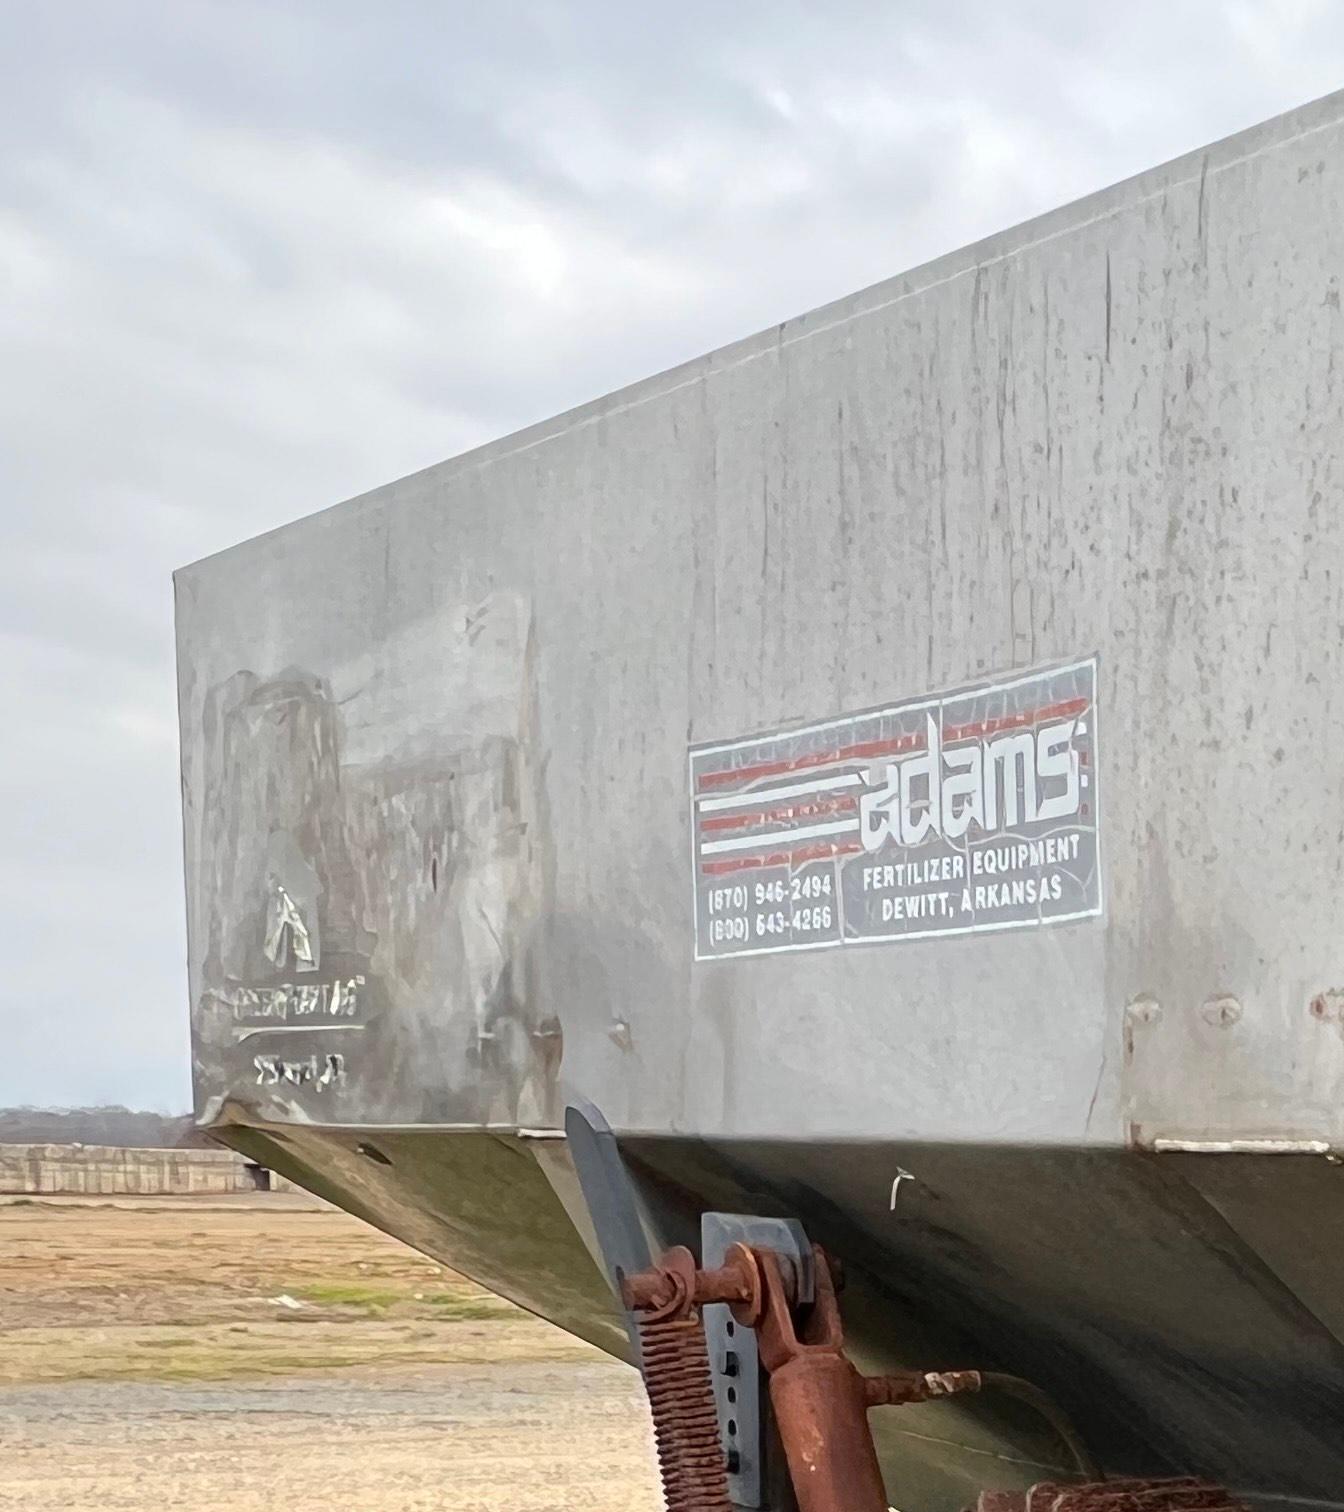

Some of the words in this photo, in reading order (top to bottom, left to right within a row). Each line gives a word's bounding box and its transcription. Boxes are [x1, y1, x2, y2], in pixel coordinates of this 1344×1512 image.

[860, 712, 1080, 851] adams
[863, 855, 964, 891] FERTILIZER
[973, 834, 1080, 875] EQUIPMENT
[755, 874, 832, 905] 946-2494
[882, 892, 954, 921] DEWITT,
[961, 875, 1062, 912] ARKANSAS
[756, 906, 832, 936] 643-4266
